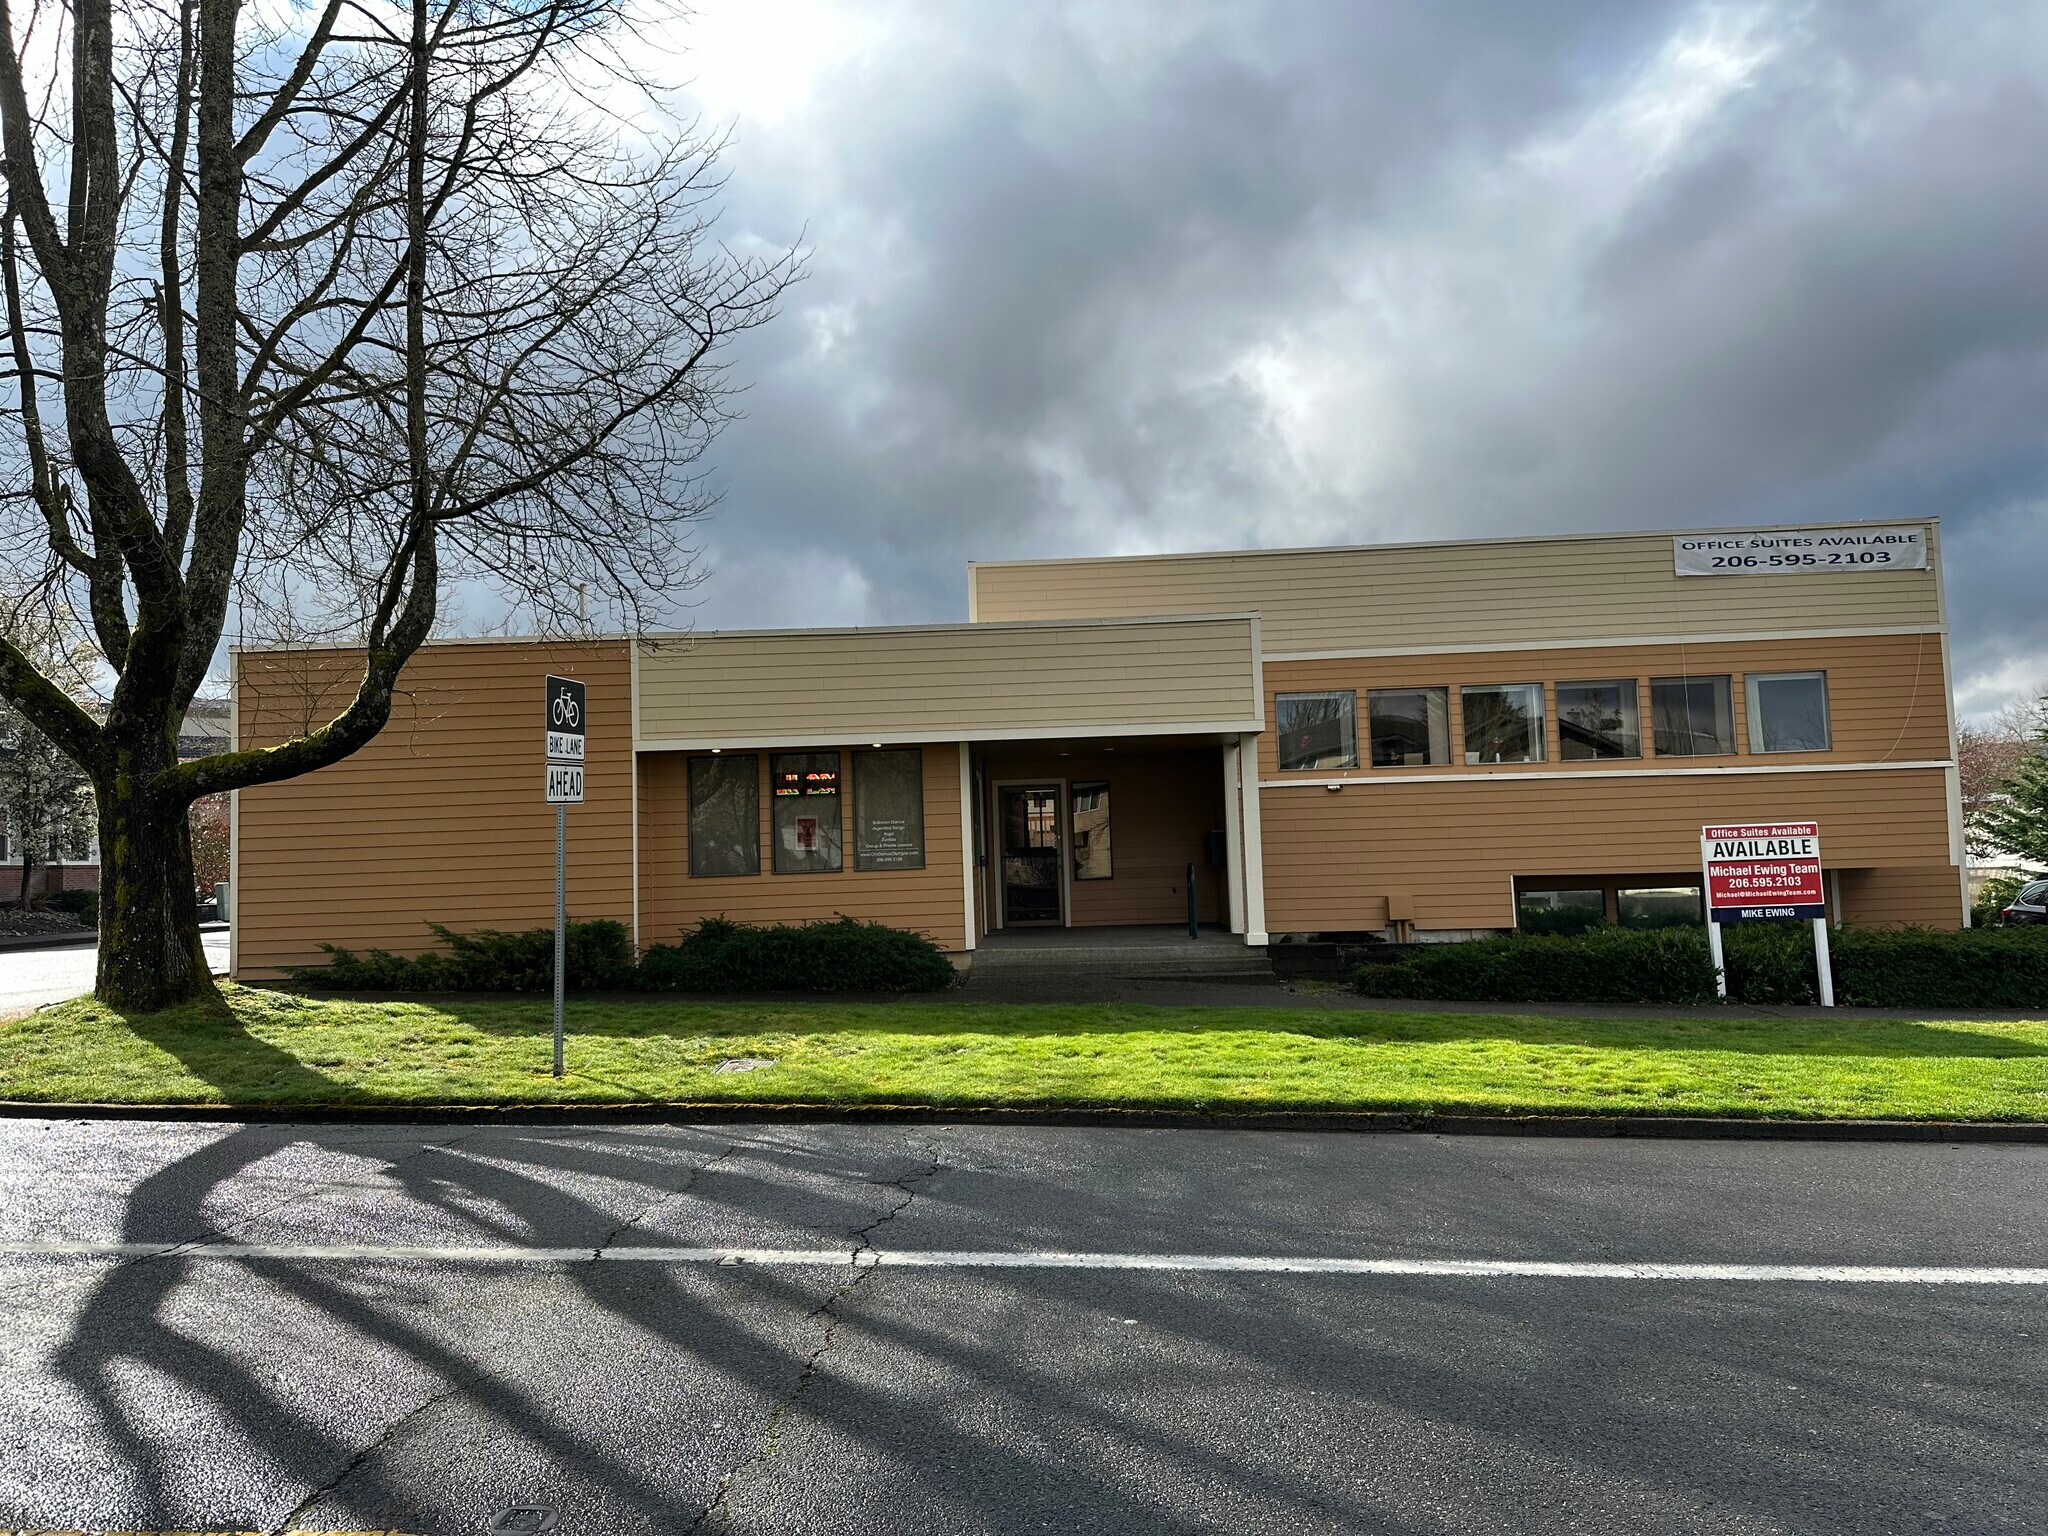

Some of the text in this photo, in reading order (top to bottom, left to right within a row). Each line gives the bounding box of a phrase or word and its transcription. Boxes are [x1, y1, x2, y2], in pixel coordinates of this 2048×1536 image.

[1681, 534, 1918, 551] OFFICE SUITES AVAILABLE
[1711, 551, 1892, 568] 206-595-2103
[549, 735, 582, 755] BIKE LANE
[548, 770, 582, 797] AHEAD
[1711, 826, 1811, 838] Office Suites Available
[1713, 839, 1812, 858] AVAILABLE
[1710, 863, 1818, 877] Michael Ewing Team
[1729, 876, 1801, 888] 206.595.2103
[1716, 889, 1816, 898] Michael@MichaelEwingTeam.com
[1741, 908, 1795, 918] MIKE EWING
